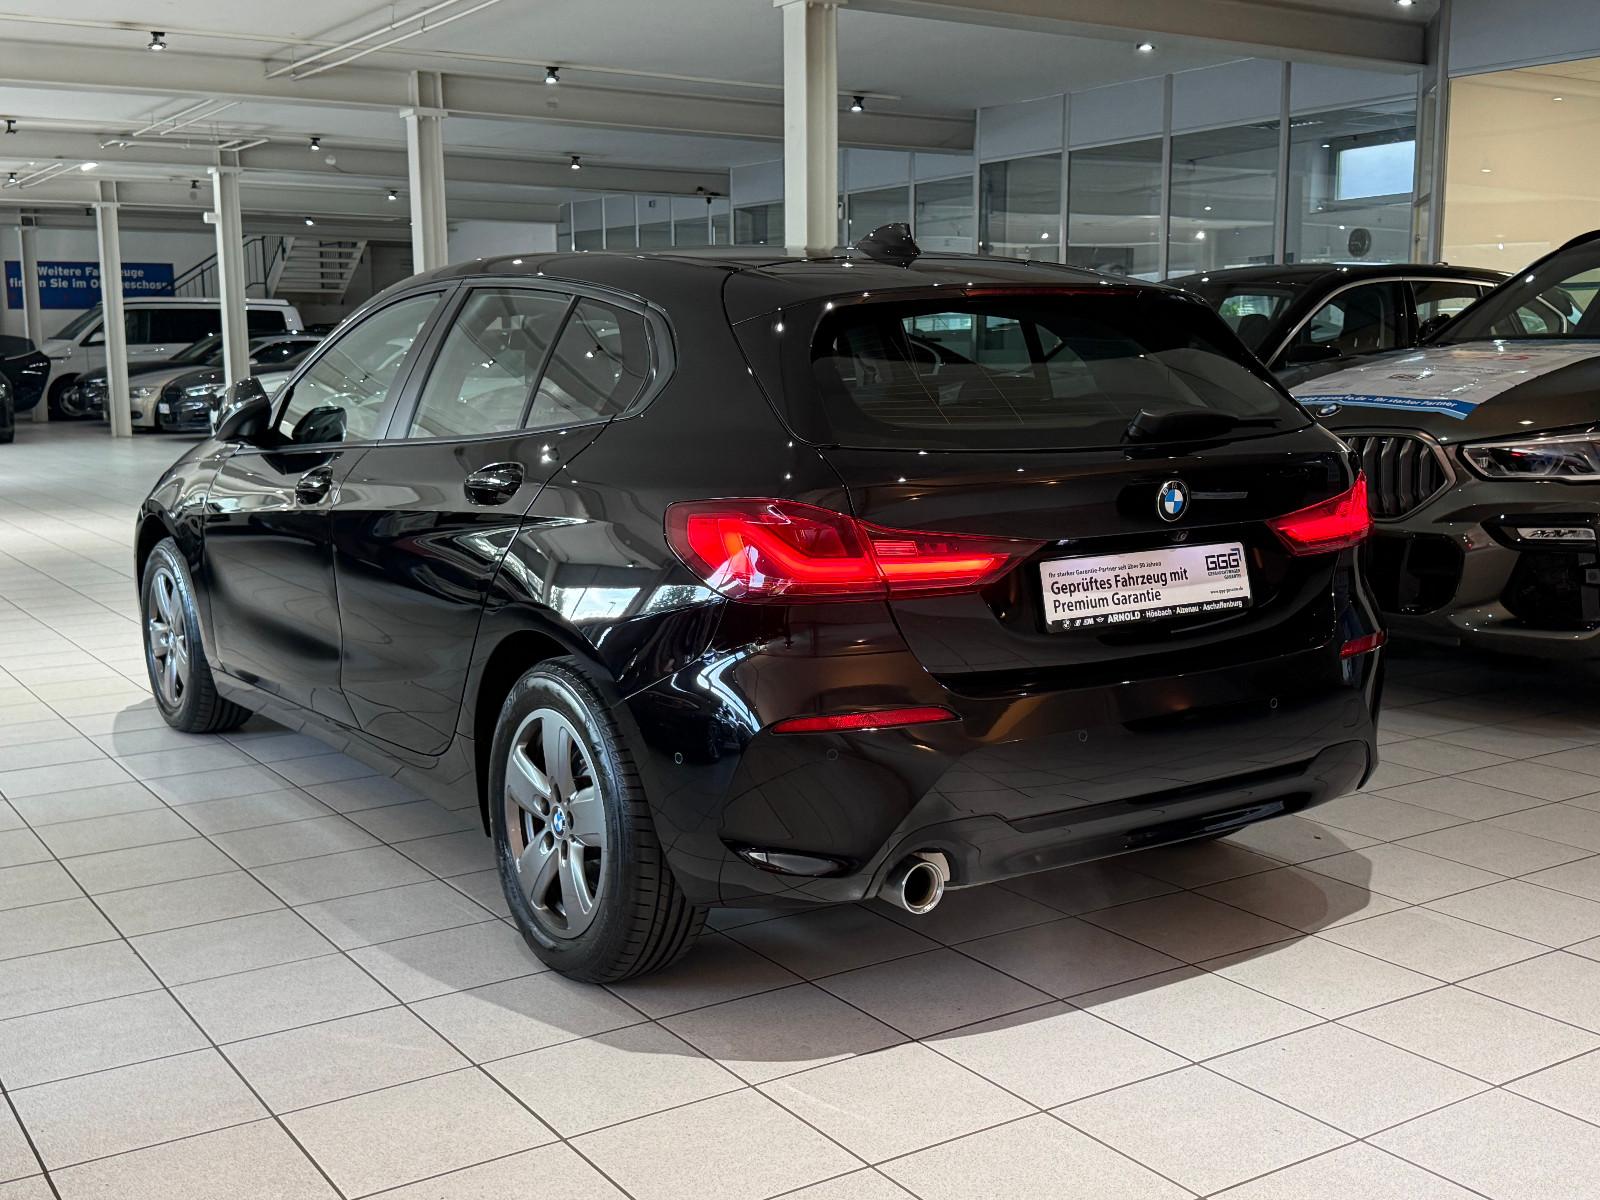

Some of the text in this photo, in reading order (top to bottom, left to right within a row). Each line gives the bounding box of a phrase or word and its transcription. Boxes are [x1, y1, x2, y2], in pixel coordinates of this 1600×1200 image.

[37, 266, 81, 277] Weitere
[9, 277, 46, 288] finn
[50, 278, 69, 288] Sie
[72, 278, 87, 288] im
[1421, 400, 1457, 408] Partner
[1205, 552, 1240, 571] GGG
[1051, 567, 1188, 597] Geprüftes Fahrzeug mit
[1053, 588, 1161, 613] Premium Garantie
[1107, 611, 1141, 623] ARNOLD
[1146, 608, 1172, 618] Hösbach
[1176, 605, 1199, 614] Alzenau
[1203, 600, 1242, 611] Aschaffenburg
